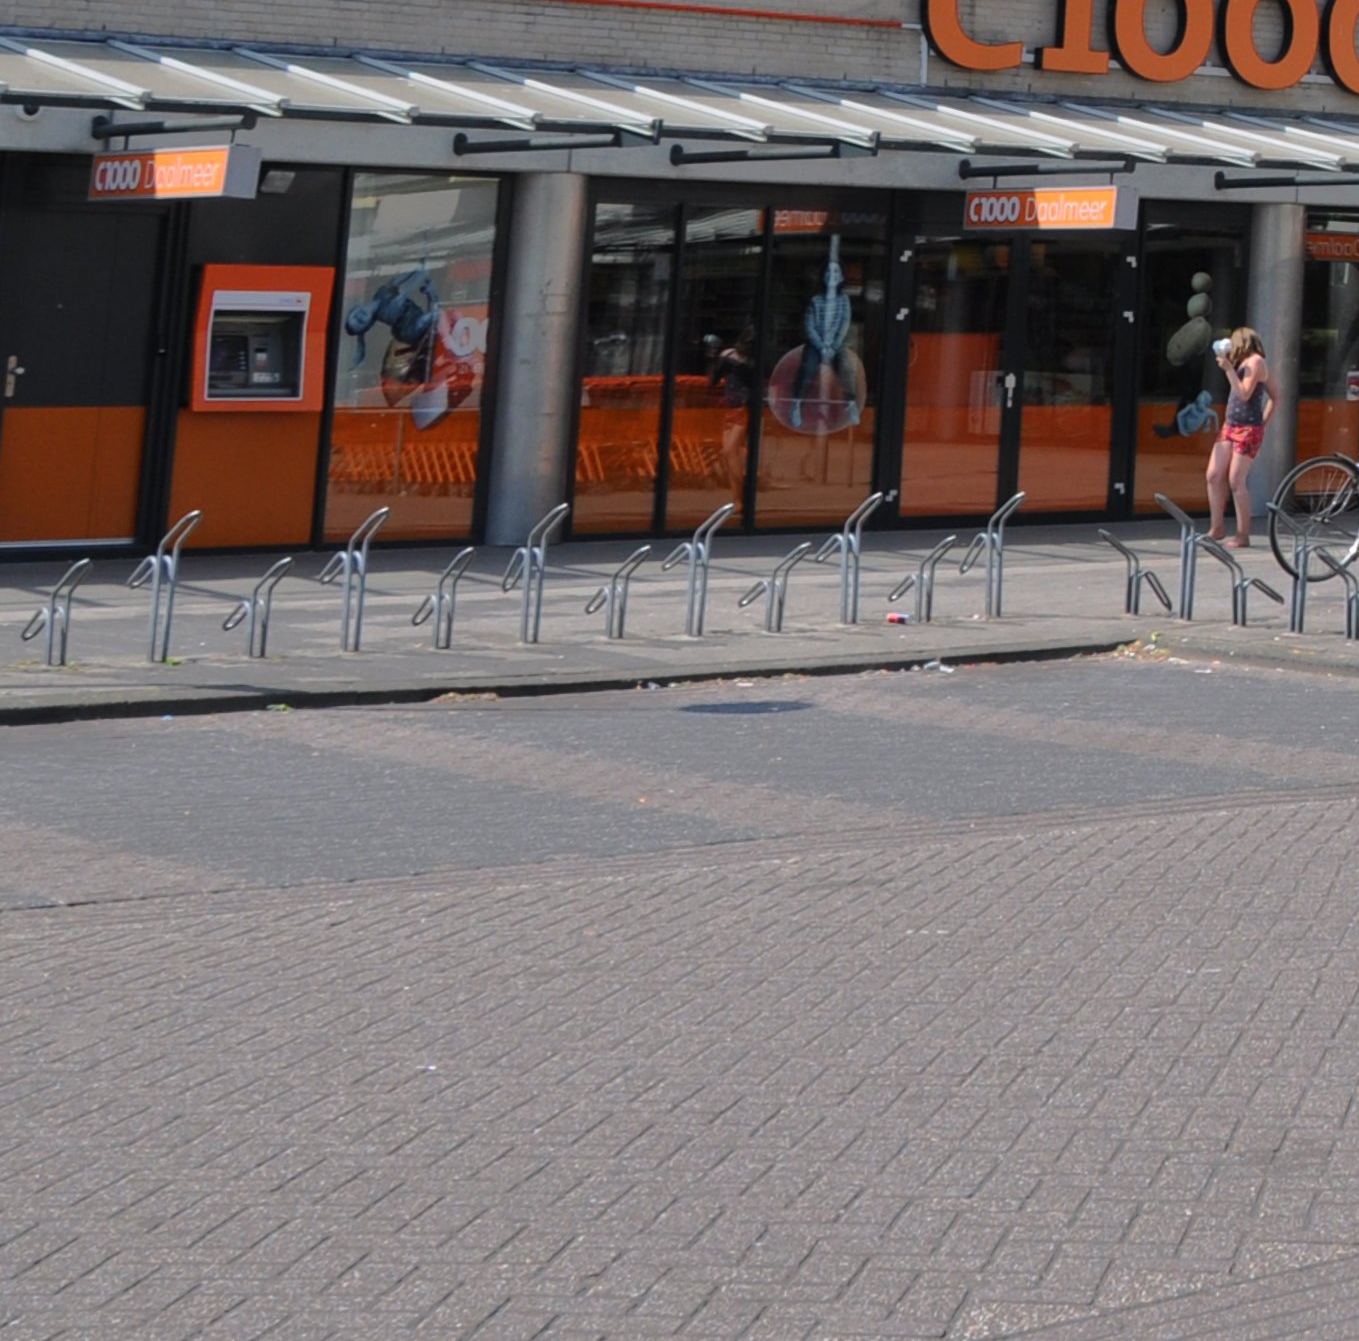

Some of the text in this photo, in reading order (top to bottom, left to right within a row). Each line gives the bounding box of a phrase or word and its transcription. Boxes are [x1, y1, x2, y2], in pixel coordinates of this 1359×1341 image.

[95, 156, 219, 191] C1000 Daalmeer
[969, 194, 1108, 223] C1000 Daalmeer
